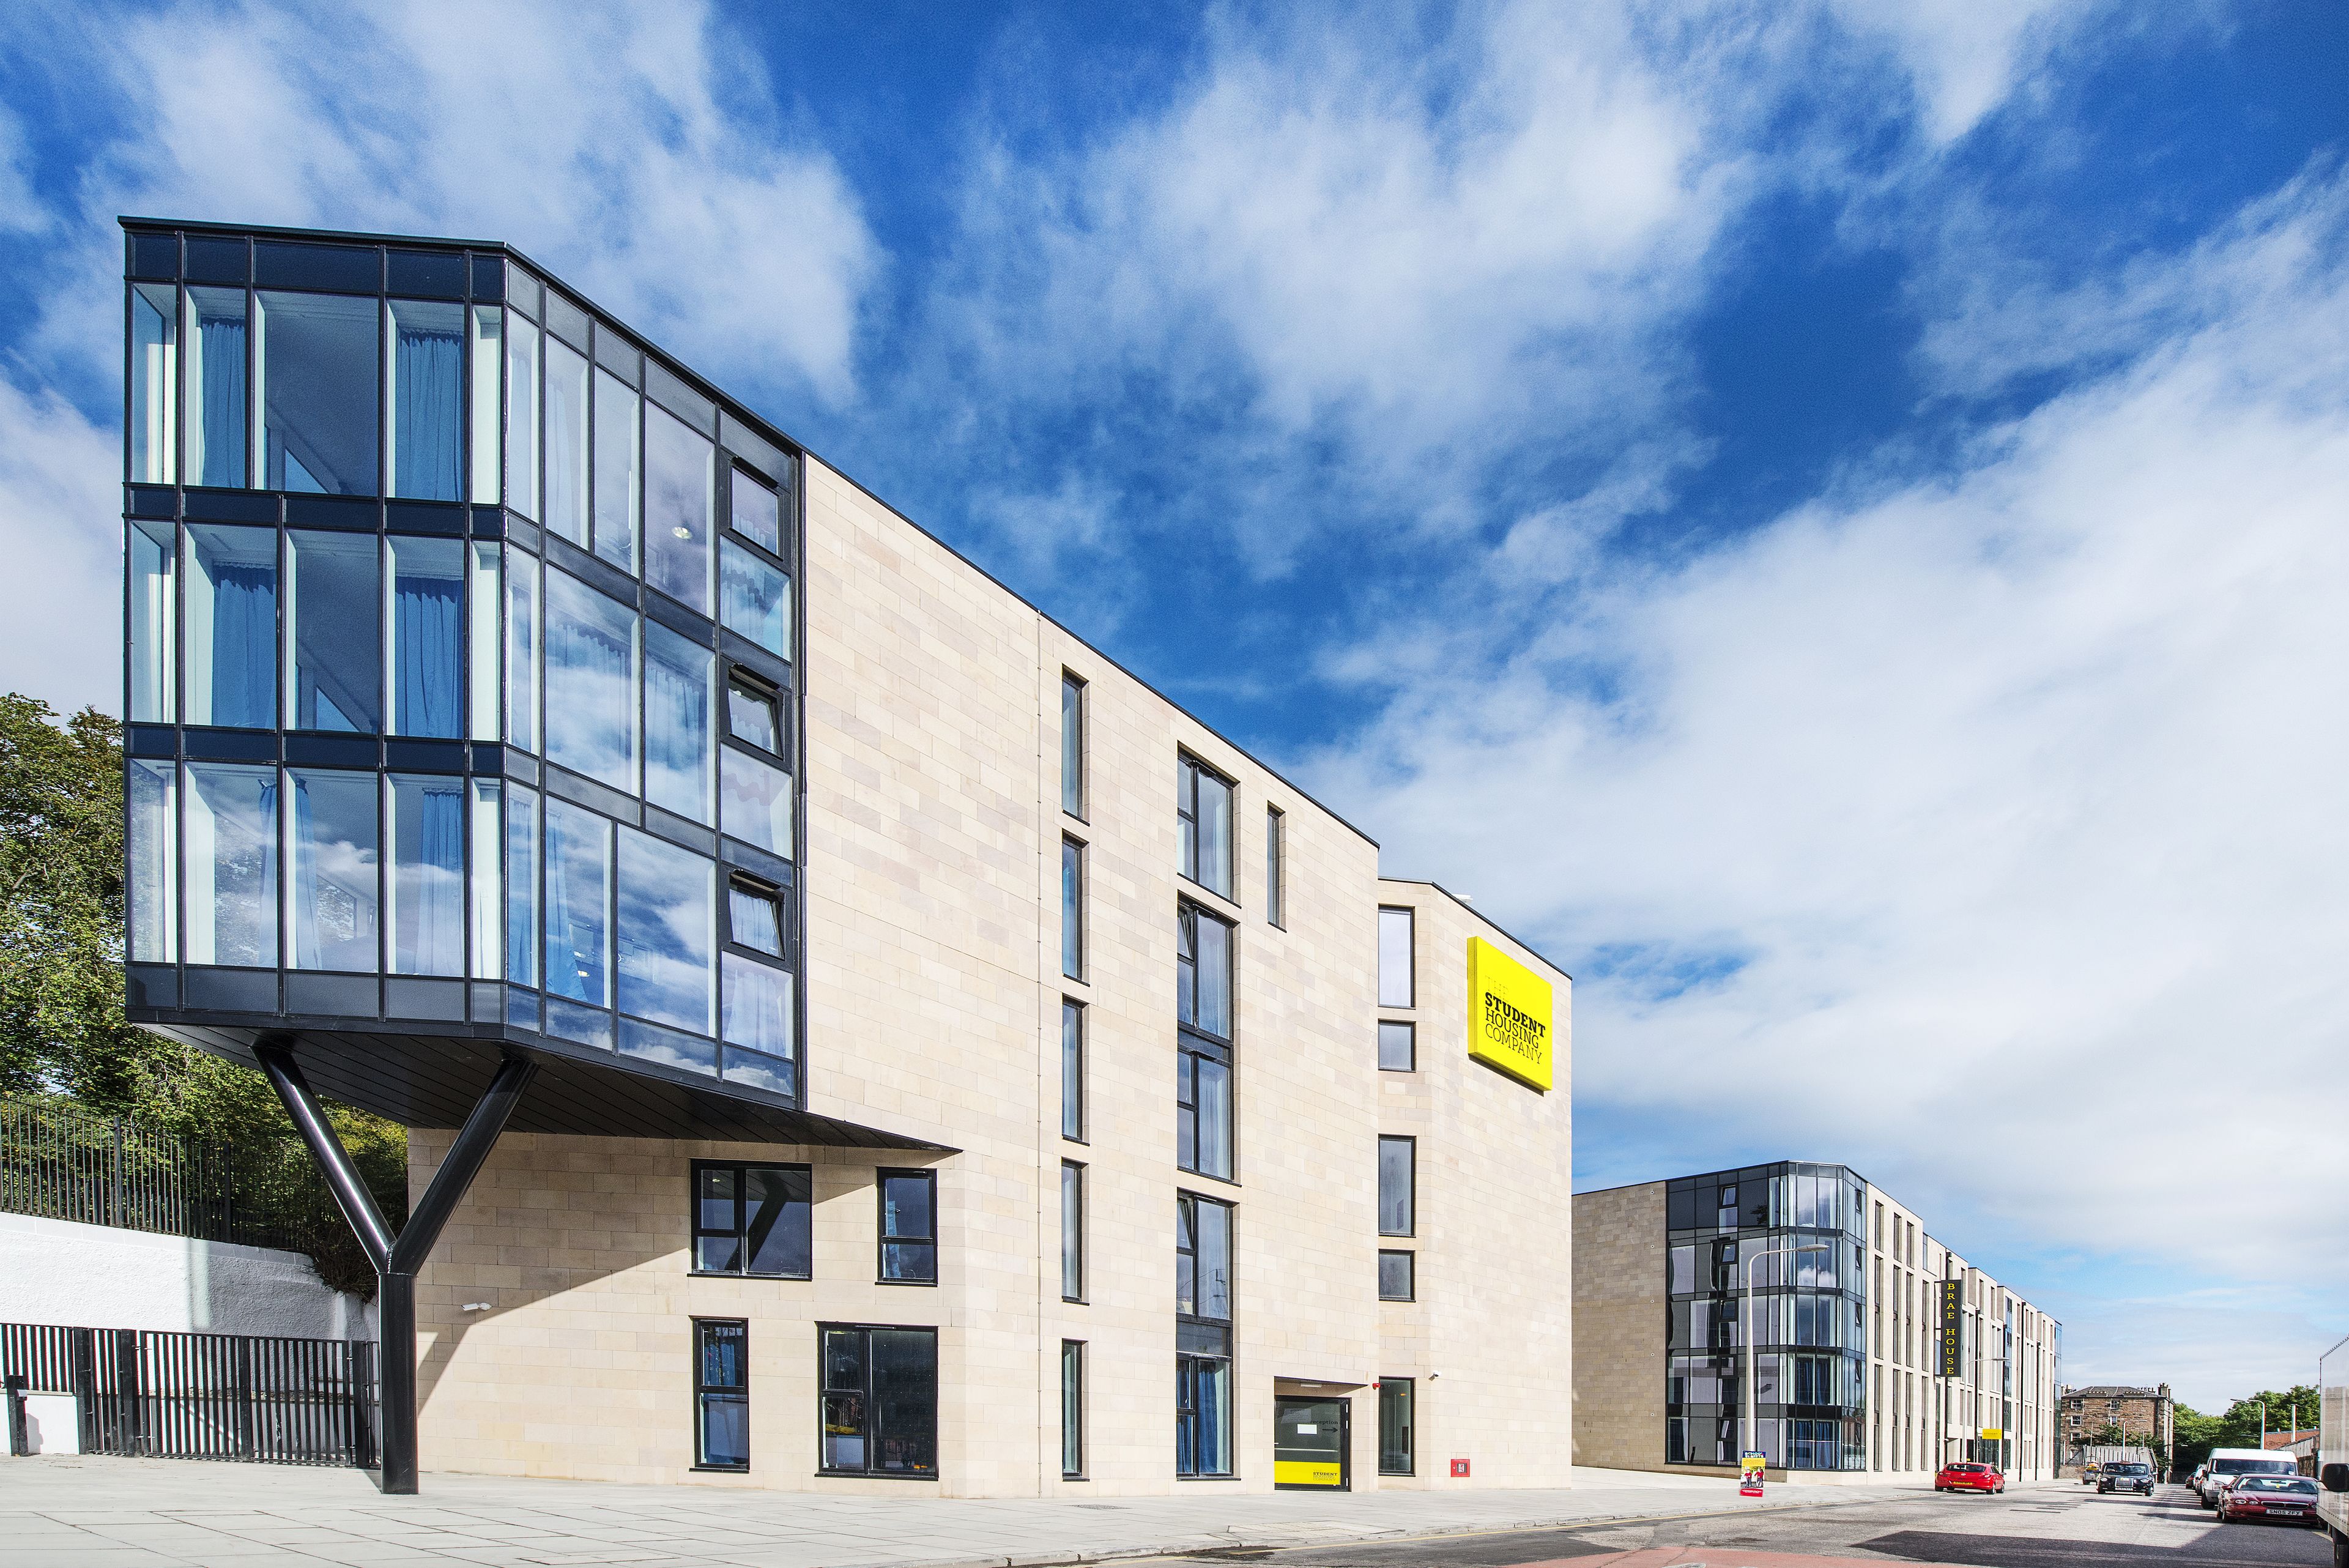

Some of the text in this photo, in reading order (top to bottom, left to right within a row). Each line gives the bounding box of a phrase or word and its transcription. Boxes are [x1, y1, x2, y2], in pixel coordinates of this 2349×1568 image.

[1485, 975, 1509, 1002] THE
[1485, 992, 1546, 1038] STUDENT
[1485, 1007, 1539, 1049] HOUSING
[1485, 1024, 1542, 1065] COMPANY
[1946, 1283, 1956, 1374] BRAE HOUSE
